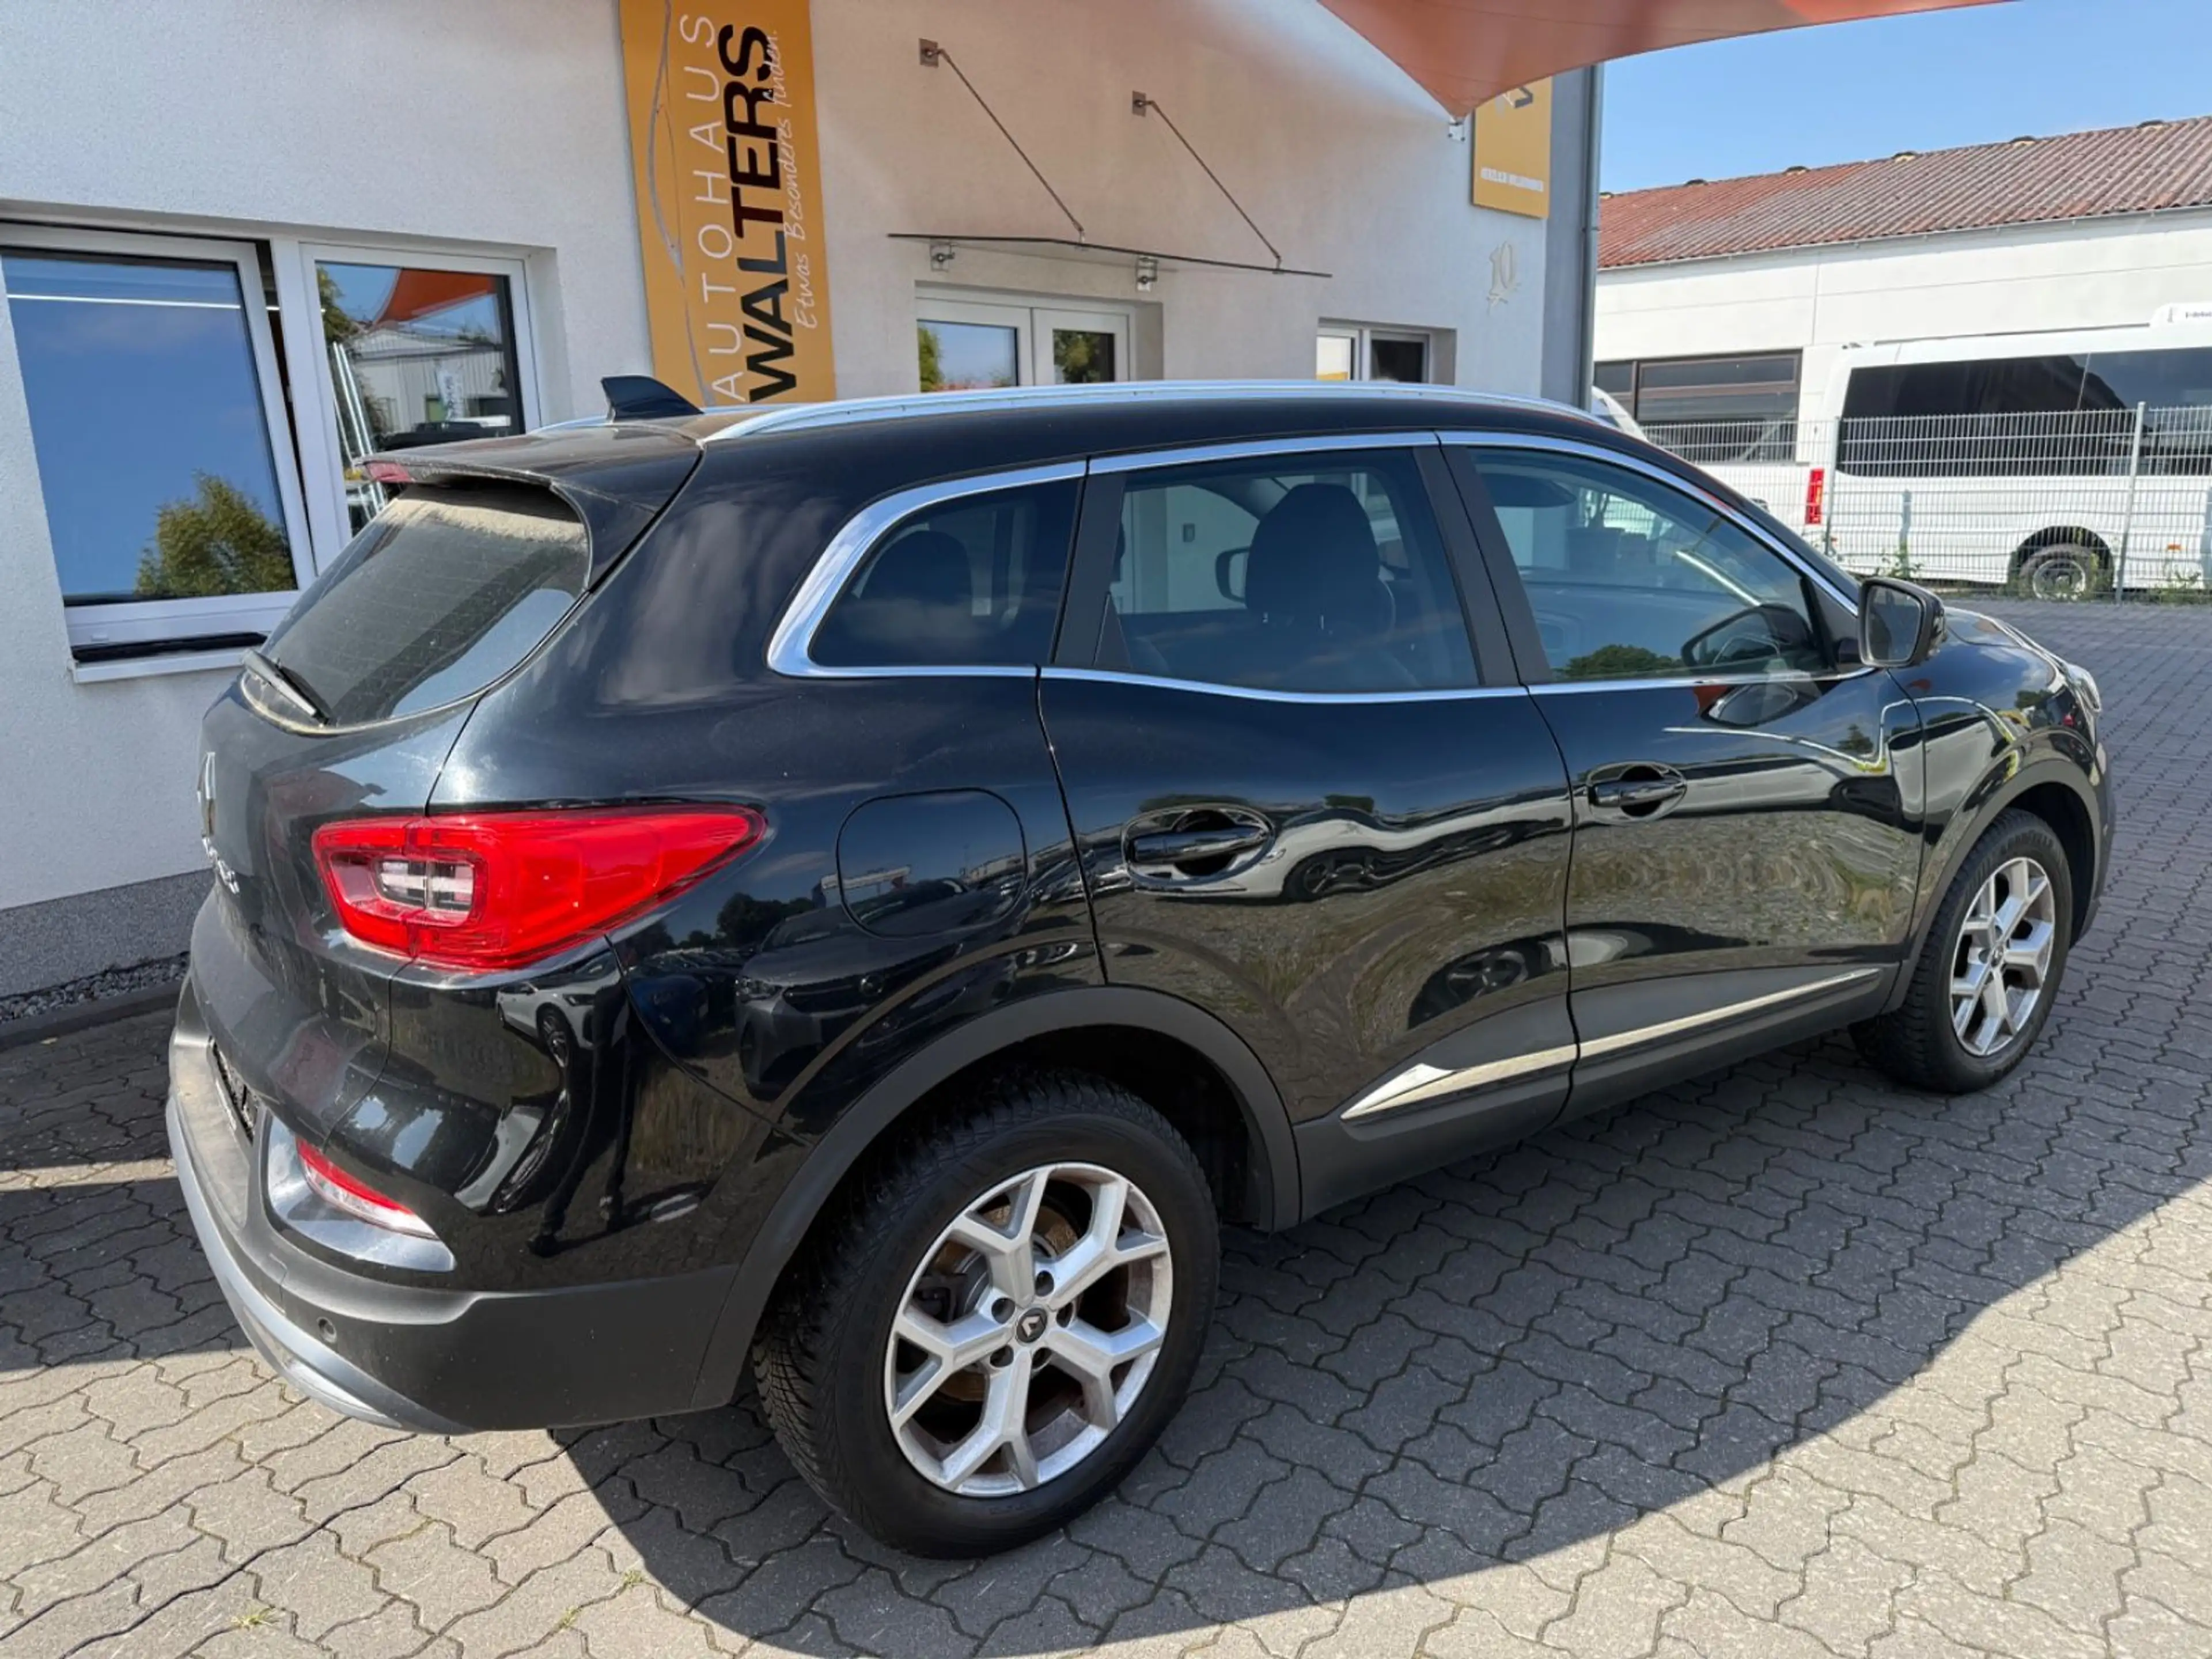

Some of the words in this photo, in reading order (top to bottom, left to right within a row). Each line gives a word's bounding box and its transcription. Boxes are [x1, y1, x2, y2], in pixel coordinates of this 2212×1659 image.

[762, 29, 793, 108] finden.
[679, 13, 746, 402] AUTOHAUS
[718, 24, 797, 403] WALTERS
[775, 118, 806, 240] Besonderes
[794, 253, 818, 329] Etwas
